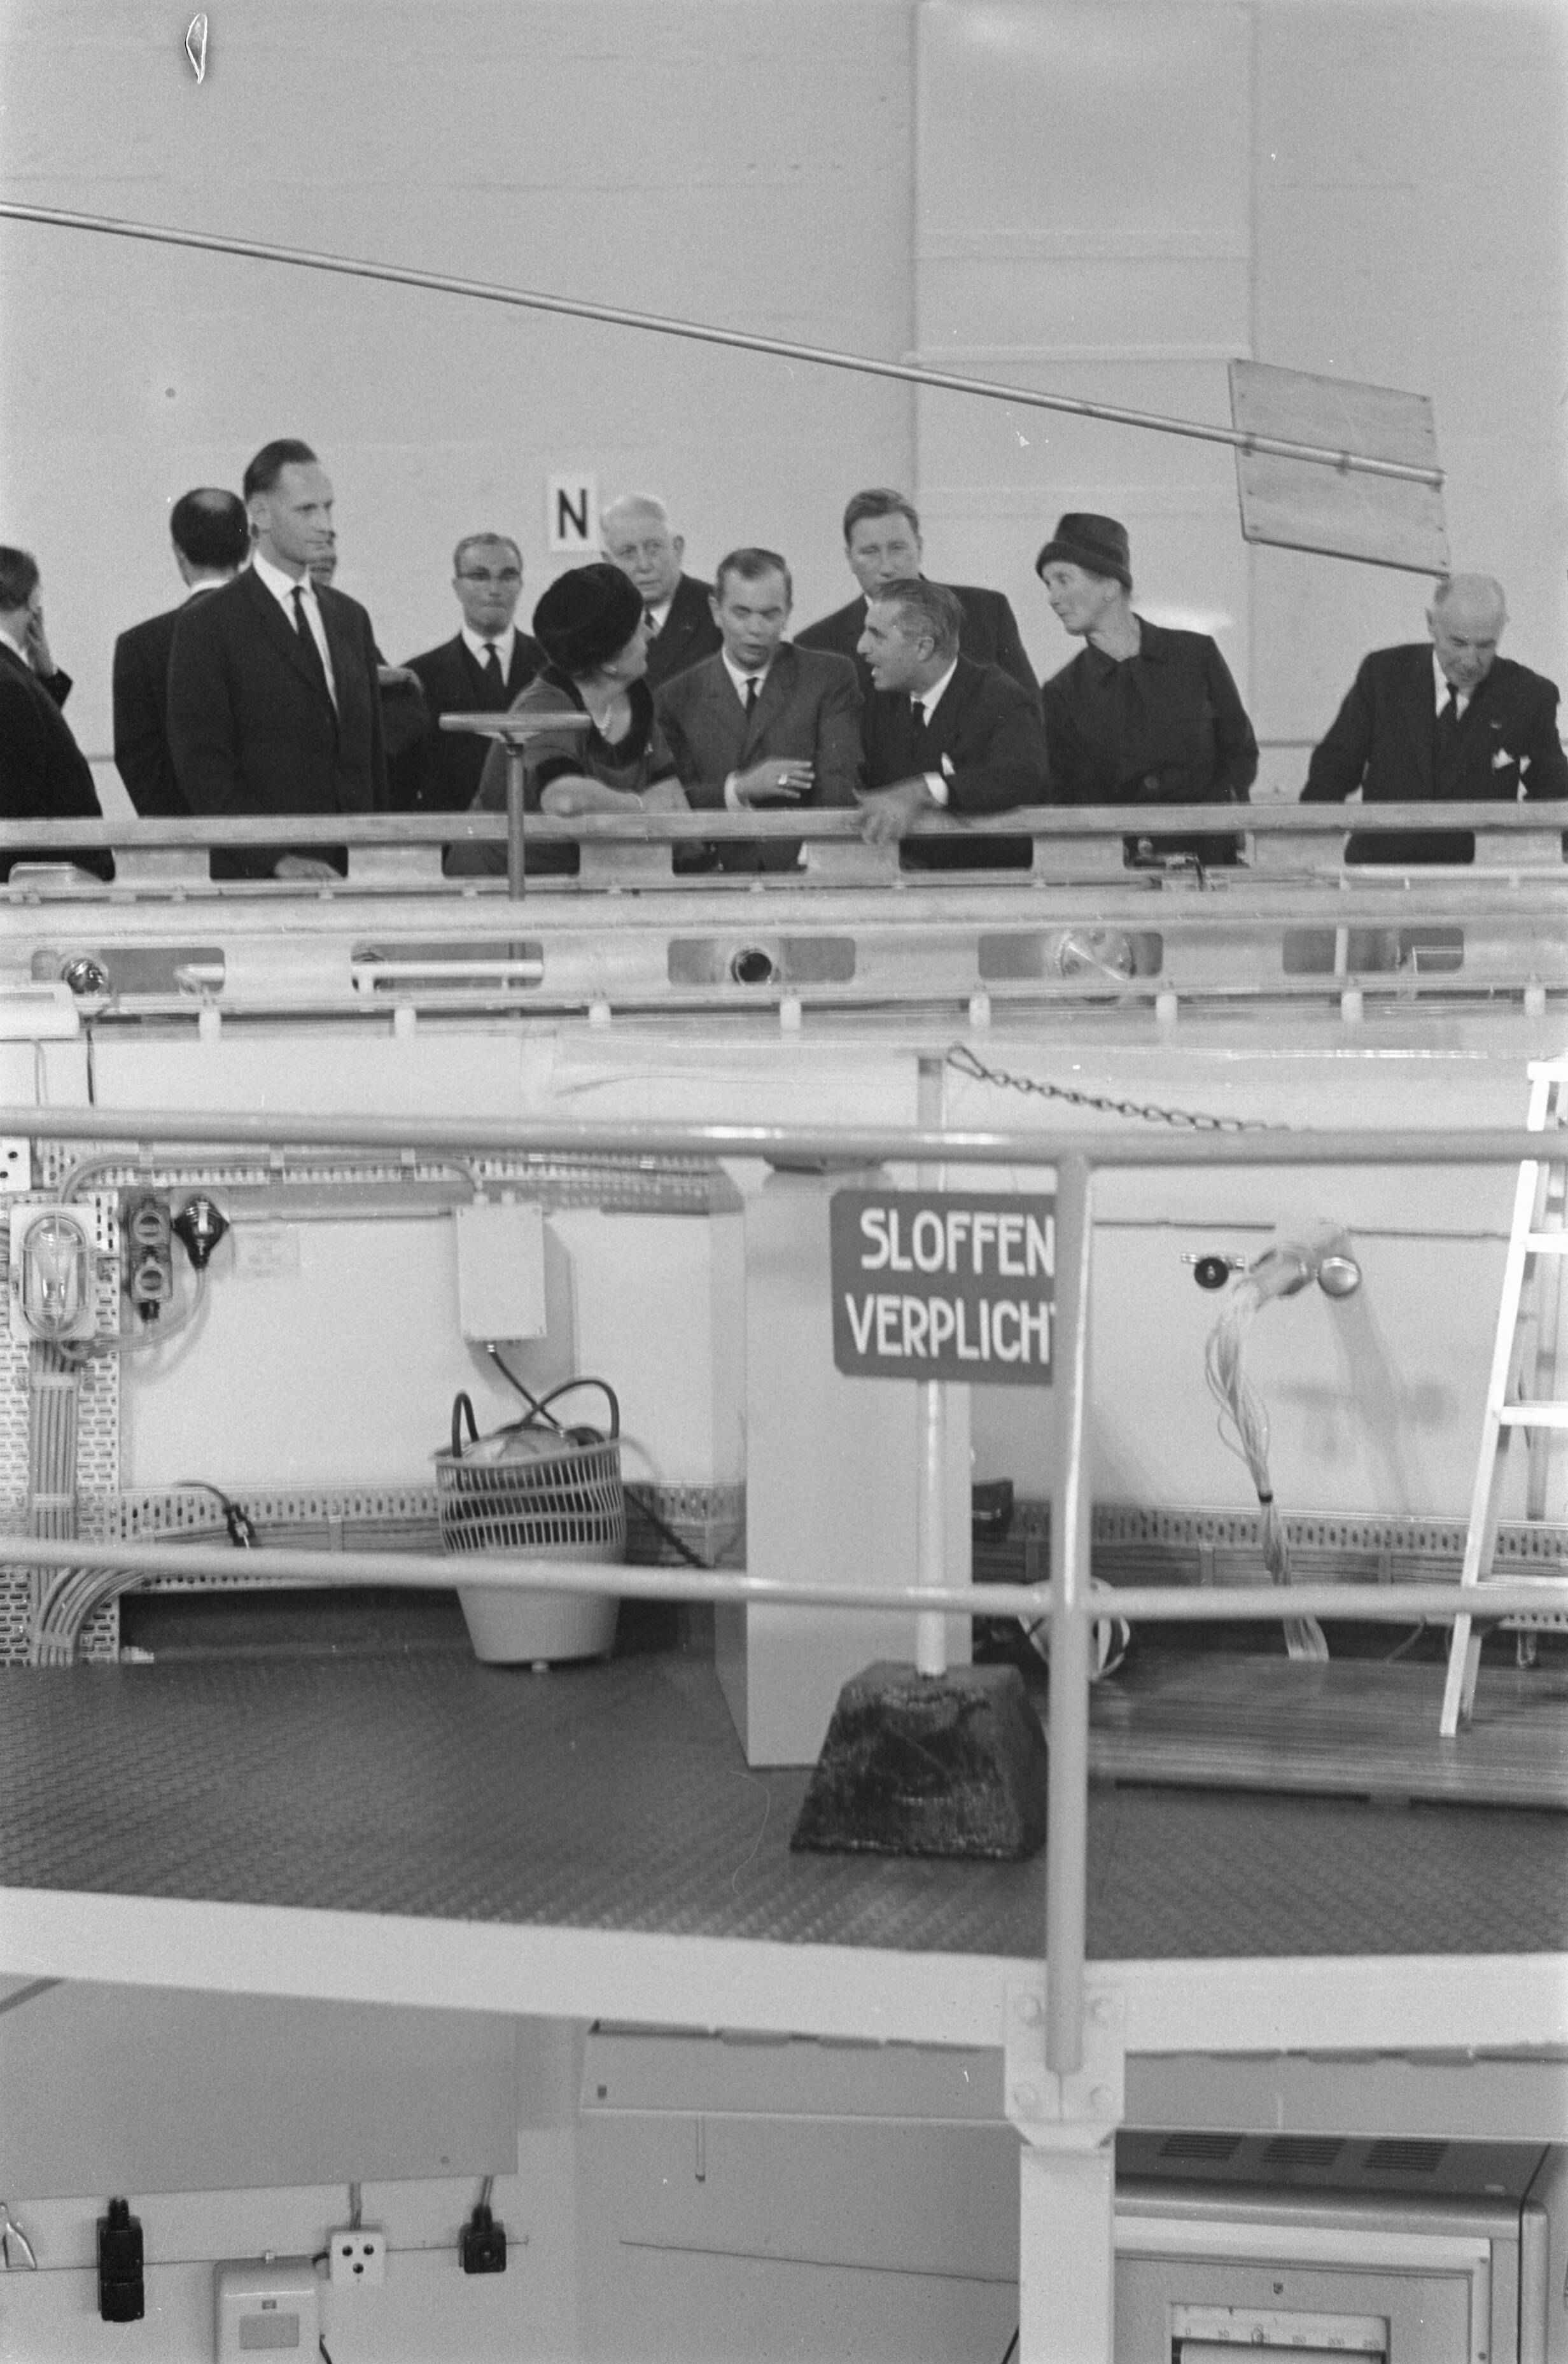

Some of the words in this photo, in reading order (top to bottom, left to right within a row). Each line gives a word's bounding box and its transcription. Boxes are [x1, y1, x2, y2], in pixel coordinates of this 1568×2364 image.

[558, 489, 587, 539] N
[860, 1207, 1055, 1278] SLOFFEN
[844, 1292, 1057, 1365] VERPLICH
